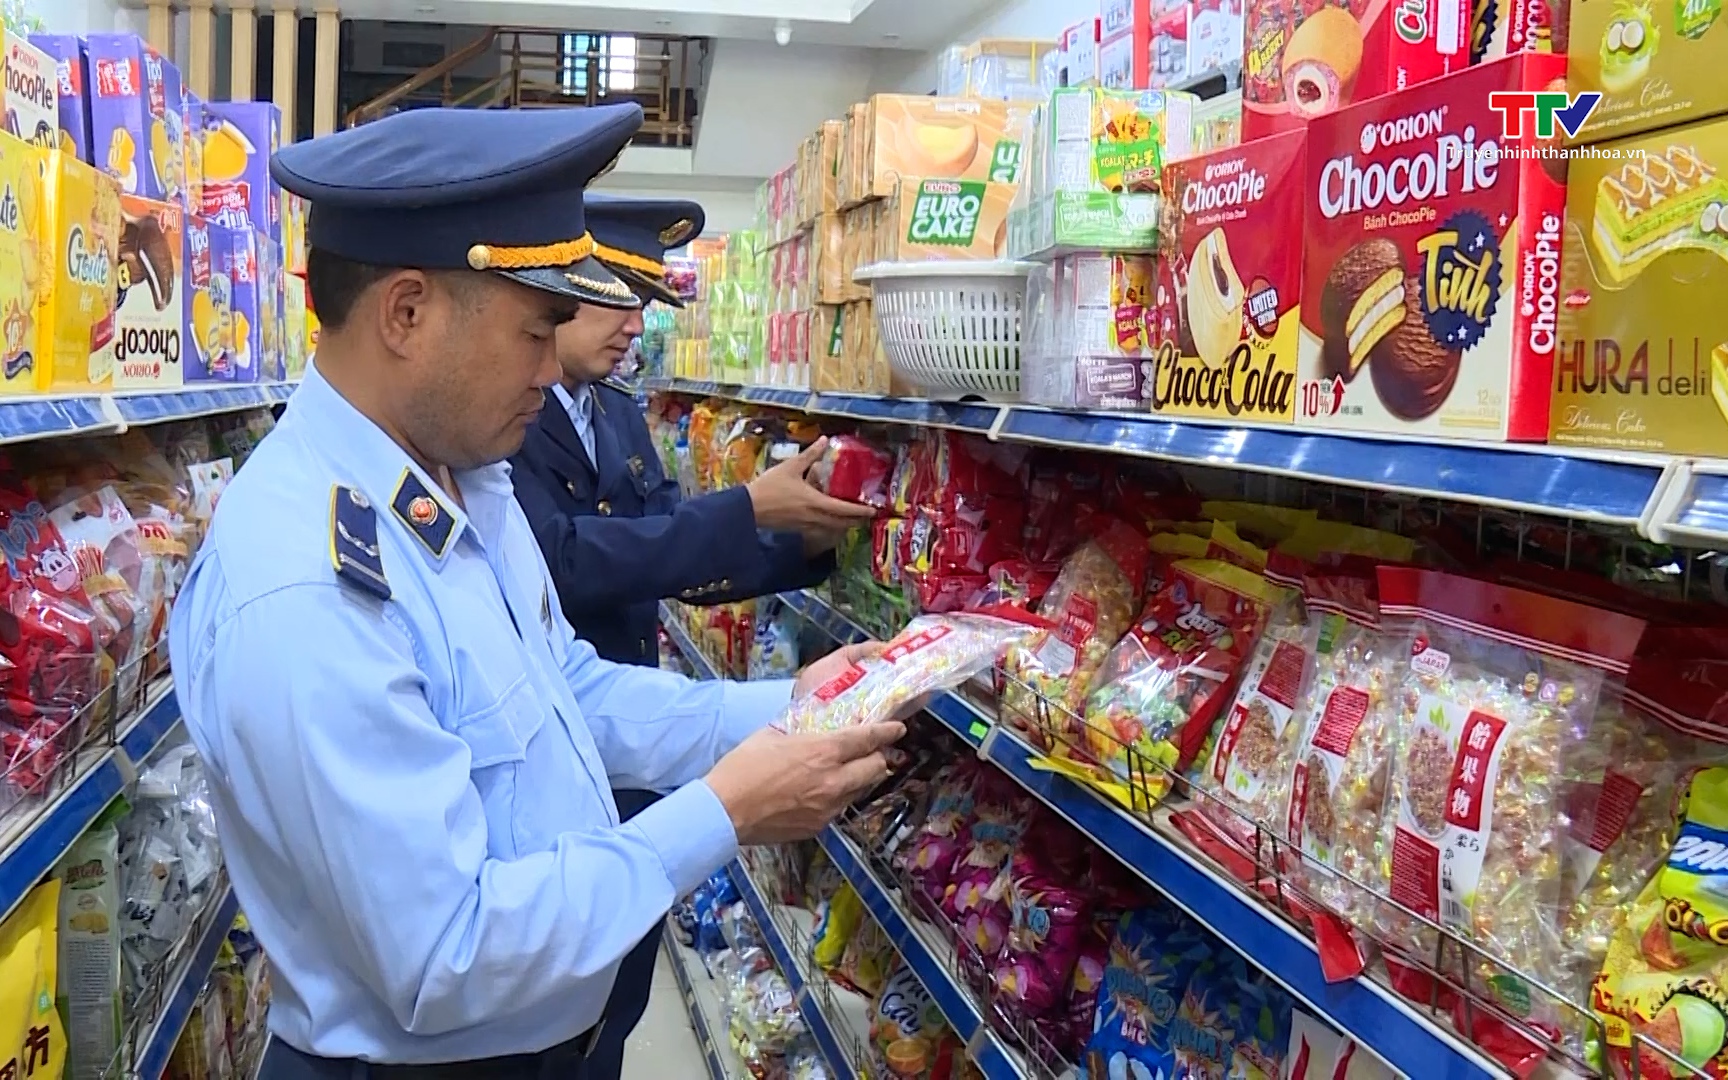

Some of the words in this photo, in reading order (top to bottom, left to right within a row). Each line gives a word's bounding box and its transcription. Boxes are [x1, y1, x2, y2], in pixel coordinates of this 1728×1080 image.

[1380, 108, 1444, 146] ORION
[1213, 159, 1244, 178] ORION
[1318, 125, 1500, 219] ChocoPie
[914, 195, 980, 218] EURO
[1181, 168, 1266, 215] ChocoPie
[911, 216, 976, 239] CAKE
[1363, 214, 1387, 231] Bánh
[1388, 206, 1437, 227] ChocoPie
[188, 226, 208, 254] Tipo
[1416, 230, 1494, 325] Tình
[1523, 252, 1535, 300] ORION
[1529, 213, 1560, 355] ChocoPie
[123, 363, 151, 378] ORION
[1152, 339, 1224, 410] Choco
[1224, 343, 1295, 416] Cola
[1557, 339, 1649, 395] HURA
[1656, 337, 1706, 396] deli
